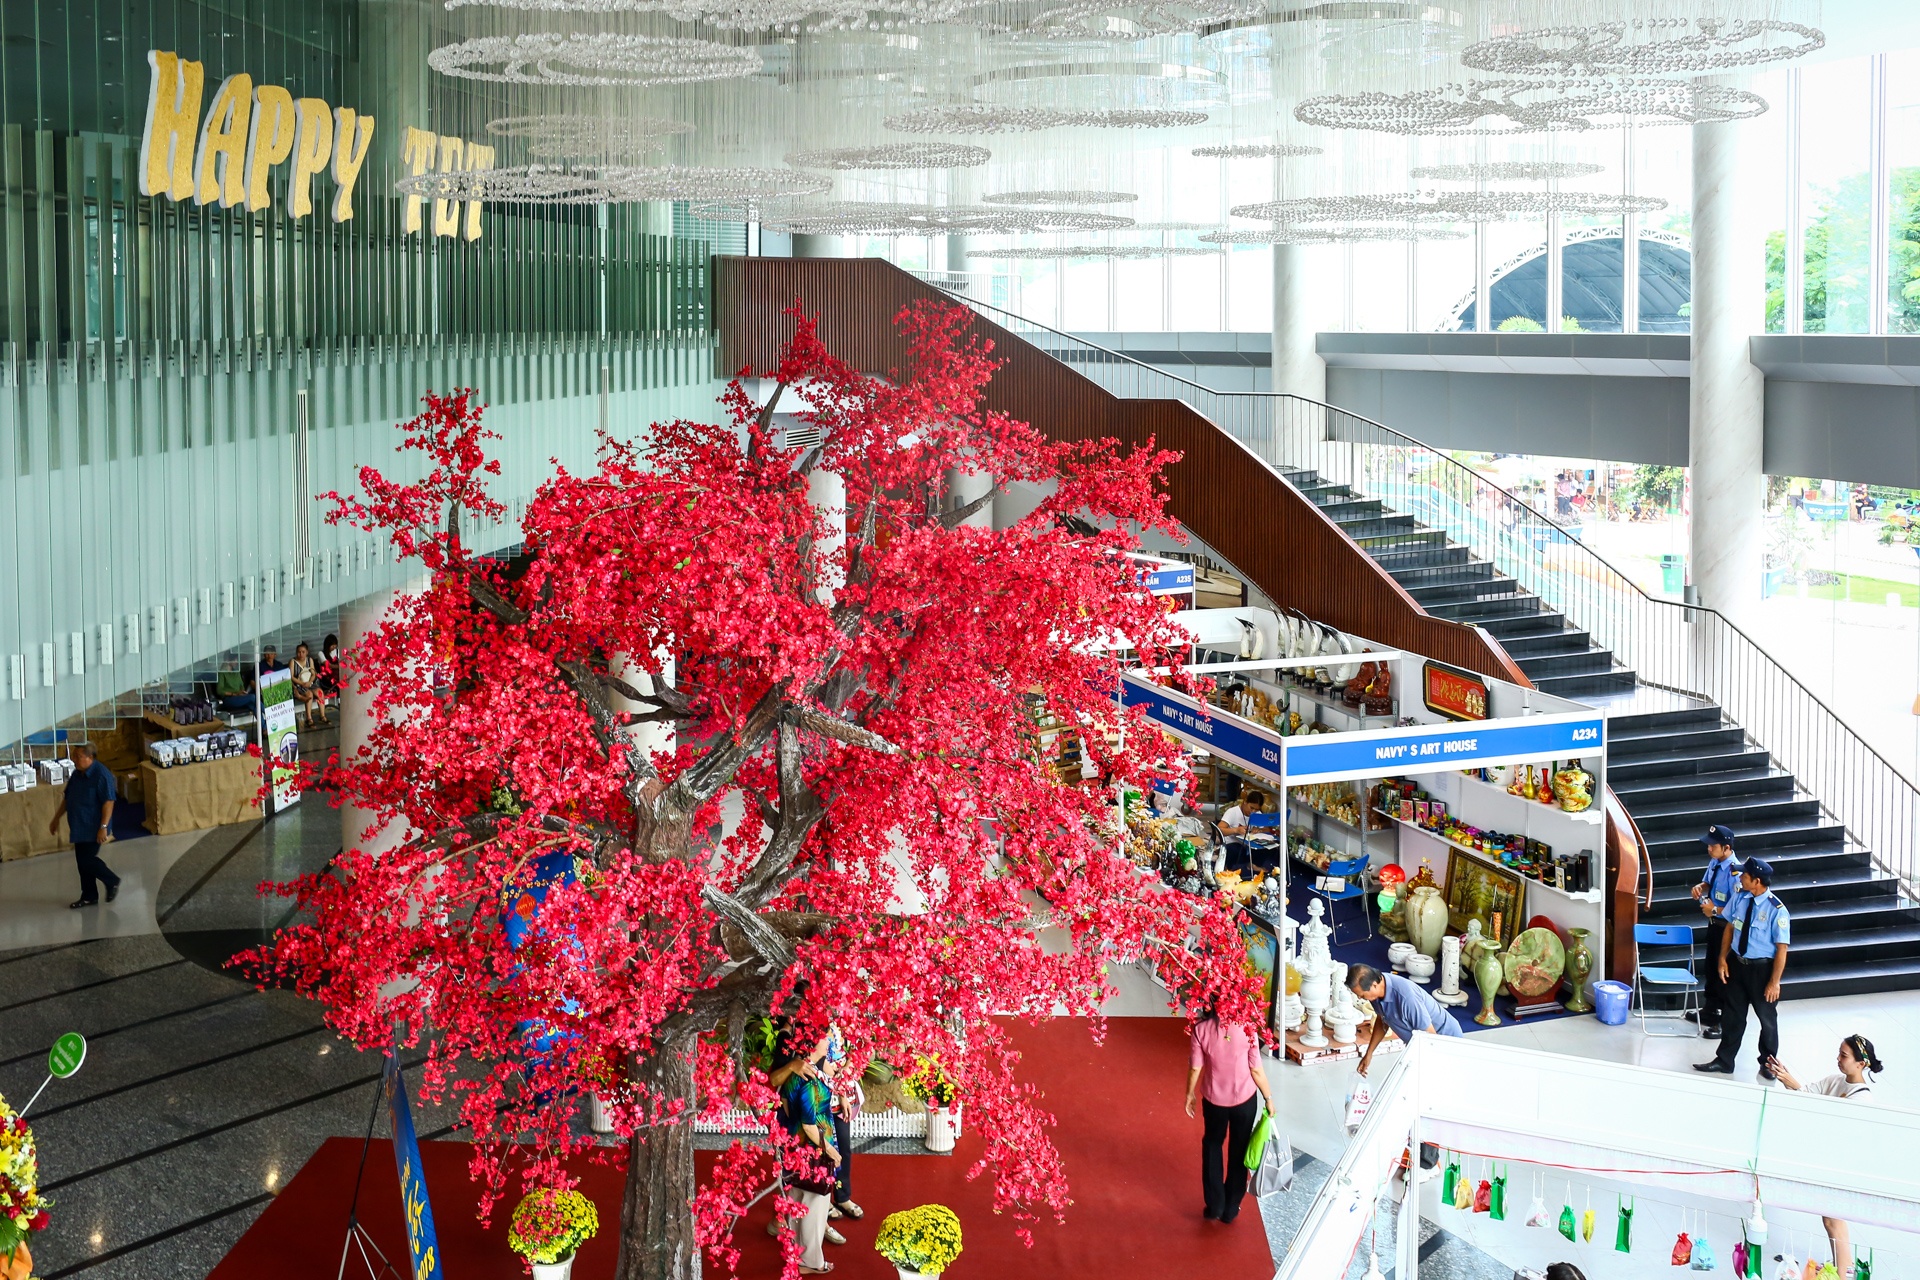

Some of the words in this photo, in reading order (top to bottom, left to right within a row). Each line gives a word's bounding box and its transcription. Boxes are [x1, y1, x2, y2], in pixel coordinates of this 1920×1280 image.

[139, 49, 374, 223] HAPPY
[1176, 575, 1191, 584] A235
[1179, 711, 1183, 722] S
[1184, 714, 1194, 727] ART
[1195, 718, 1213, 736] HOUSE
[1572, 727, 1597, 741] A234
[1410, 744, 1418, 756] S
[1420, 742, 1441, 755] ART
[1443, 739, 1477, 753] HOUSE
[1262, 748, 1278, 764] A234
